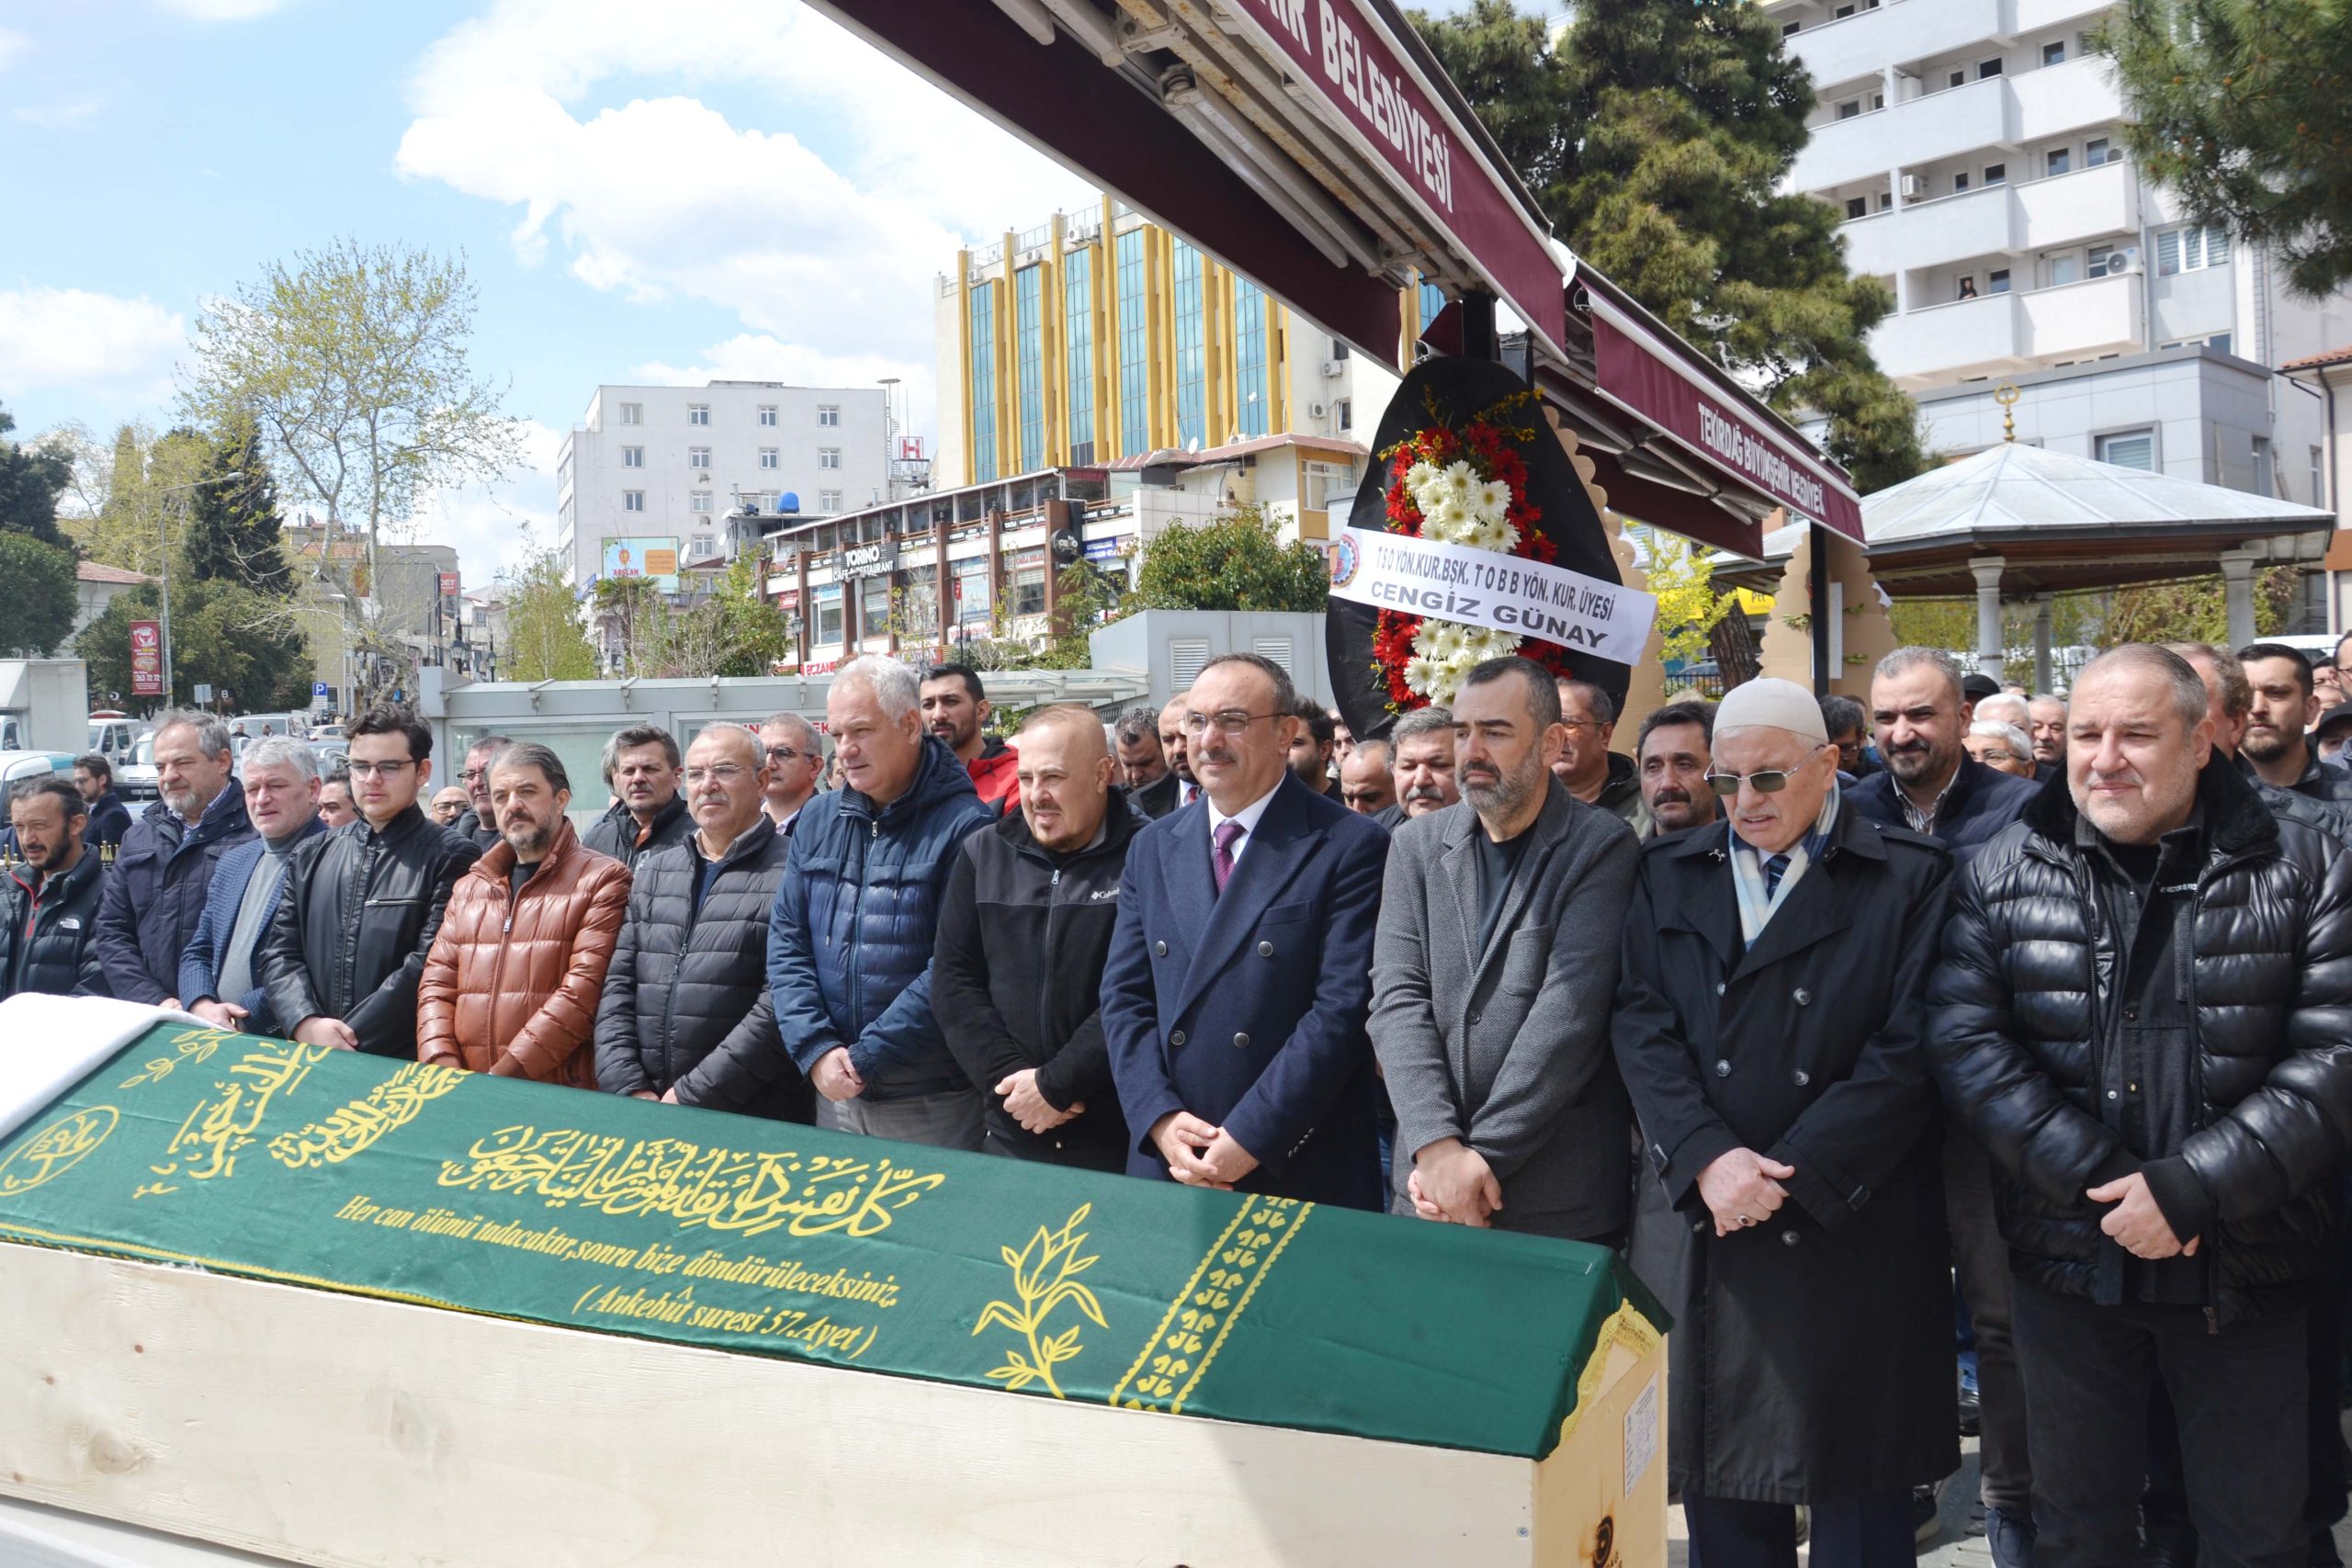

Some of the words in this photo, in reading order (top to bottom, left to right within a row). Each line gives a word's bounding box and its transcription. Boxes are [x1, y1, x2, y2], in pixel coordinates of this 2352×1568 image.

[1319, 0, 1453, 213] BELEDİYESİ
[902, 439, 920, 458] H
[1698, 402, 1744, 467] TEKİRDAĞ
[845, 545, 880, 568] TORINO
[833, 569, 849, 581] CAFE
[1371, 581, 1481, 618] CENGİZ
[1493, 604, 1610, 649] GÜNAY
[1552, 581, 1577, 611] KUR.
[1578, 585, 1617, 622] ÜYESİ
[315, 683, 324, 695] P
[334, 1195, 380, 1222] Her
[373, 1203, 415, 1229] can
[410, 1208, 484, 1240] ölümü
[635, 1244, 678, 1276] bize
[688, 1304, 767, 1334] suresi
